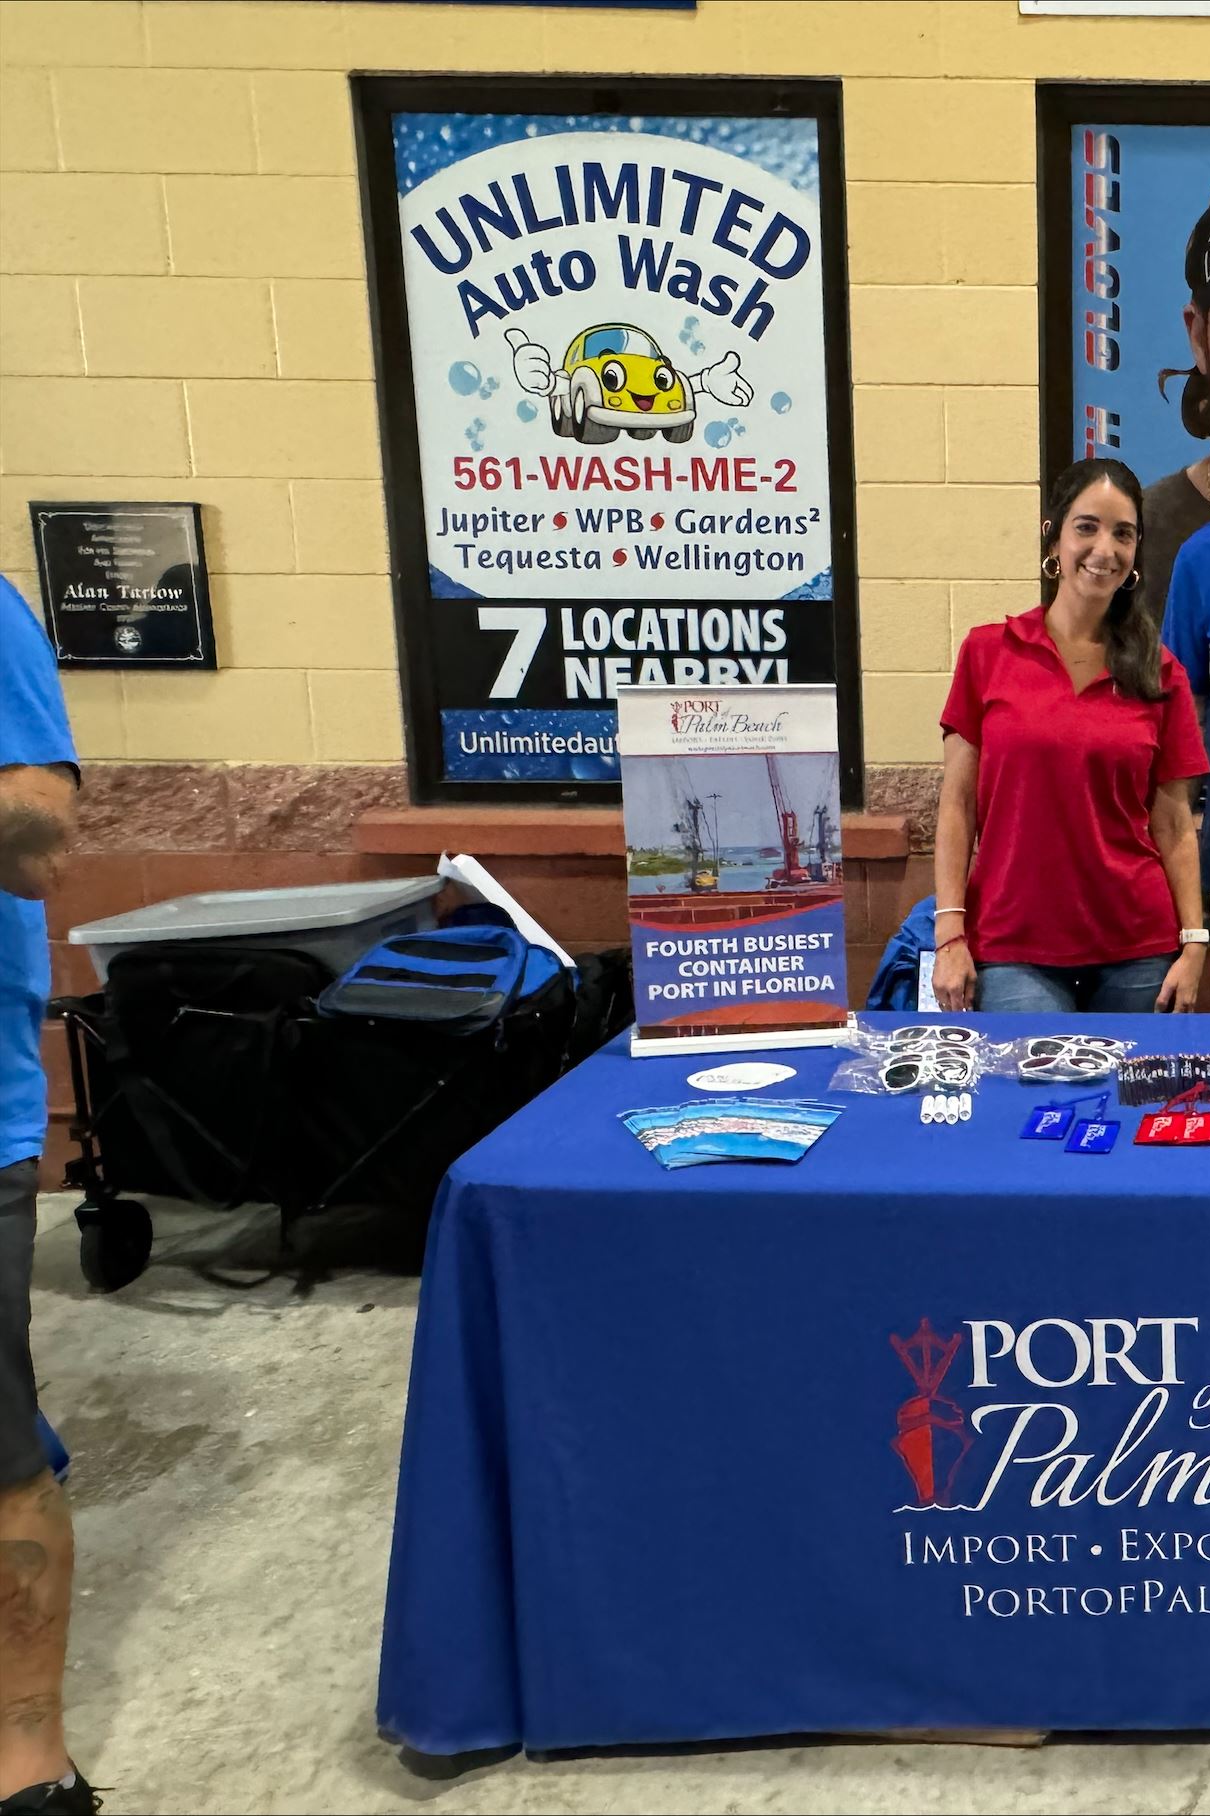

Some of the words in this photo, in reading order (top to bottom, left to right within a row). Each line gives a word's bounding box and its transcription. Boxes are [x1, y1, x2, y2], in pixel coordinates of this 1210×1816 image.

[410, 161, 812, 281] UNLIMITED
[456, 249, 597, 339] Auto
[618, 234, 776, 342] Wash
[453, 456, 798, 492] 561-WASH-ME-2
[437, 507, 545, 536] Jupiter
[575, 508, 645, 534] WPB
[454, 543, 601, 574] Tequesta
[635, 545, 804, 577] Wellington
[64, 582, 109, 599] Alan
[477, 607, 547, 699] 7
[561, 607, 787, 652] LOCATIONS
[684, 700, 722, 713] PORT
[730, 711, 788, 733] Beach
[646, 937, 738, 958] FOURTH
[743, 932, 833, 953] BUSIEST
[678, 955, 804, 977] CONTAINER
[648, 982, 709, 1001] PORT
[714, 980, 736, 997] IN
[742, 974, 835, 996] FLORIDA
[962, 1316, 1199, 1389] PORT
